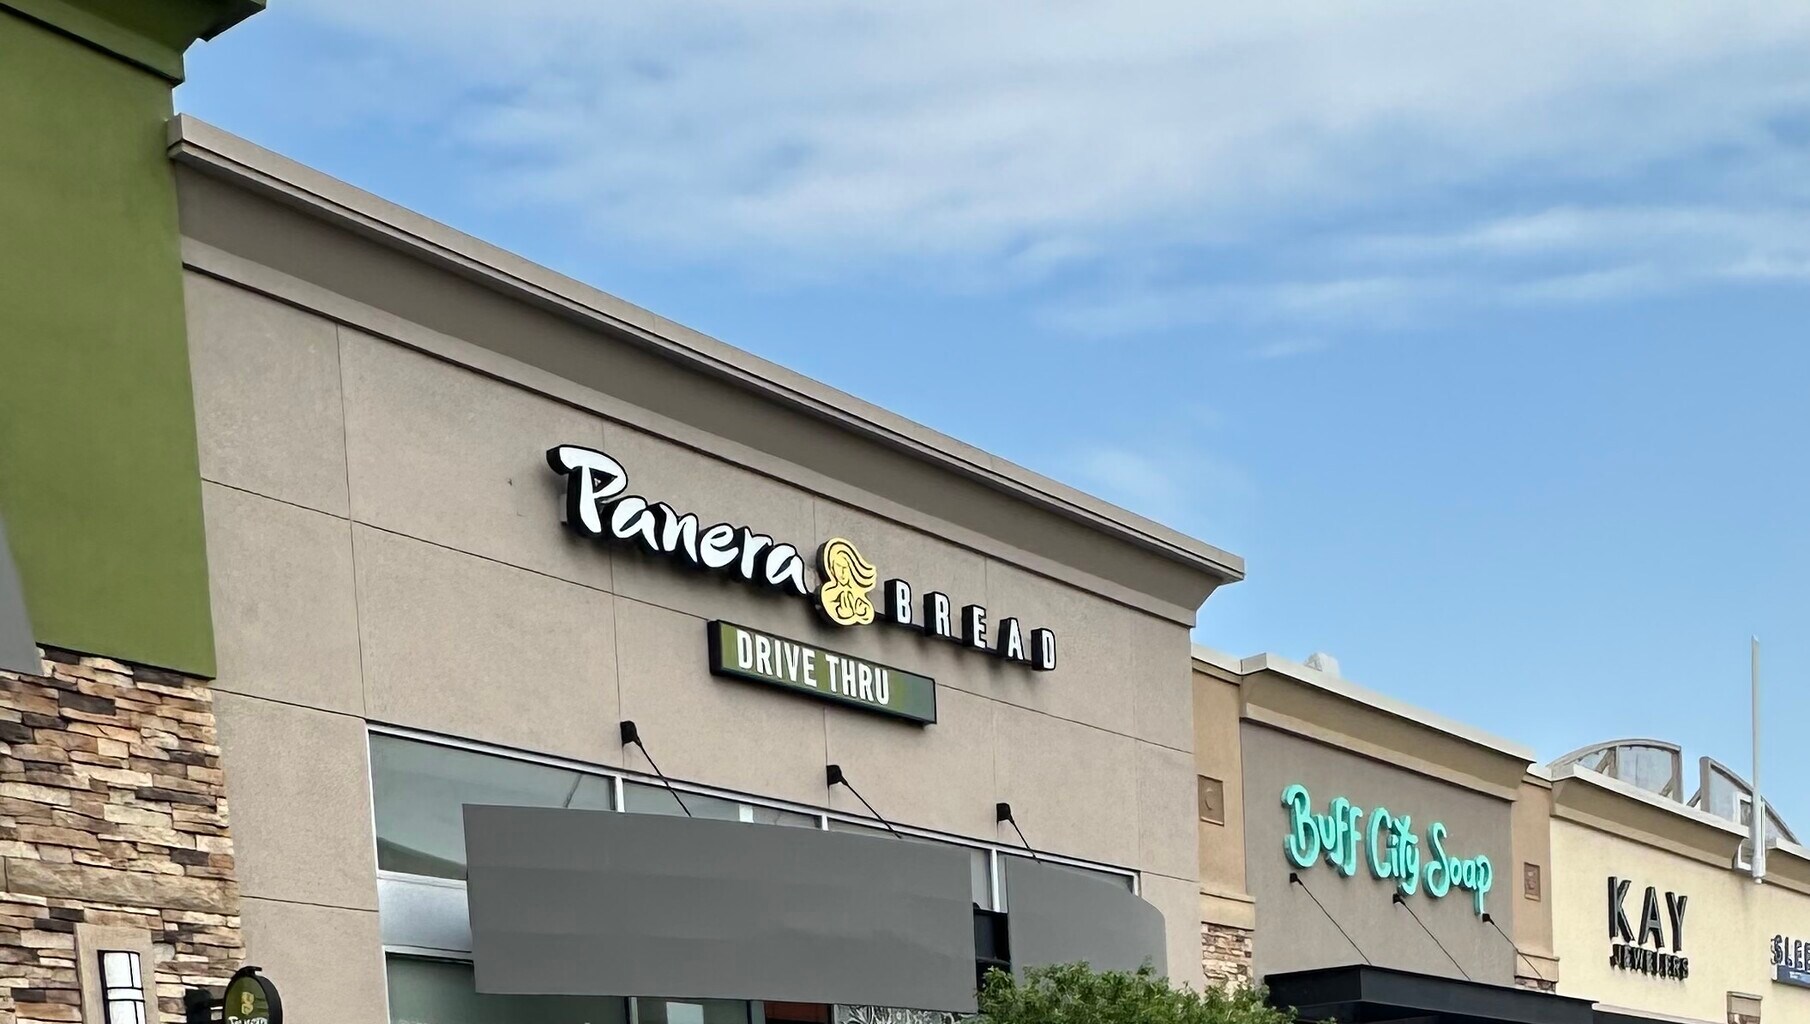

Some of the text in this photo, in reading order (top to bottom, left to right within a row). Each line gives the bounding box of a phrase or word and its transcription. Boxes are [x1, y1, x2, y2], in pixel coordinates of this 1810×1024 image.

[547, 444, 1057, 671] Panera BREAD
[736, 629, 890, 705] DRIVE THRU
[1282, 784, 1493, 917] Buff City Soap
[1608, 876, 1688, 953] KAY
[1609, 944, 1689, 981] JEWELERS
